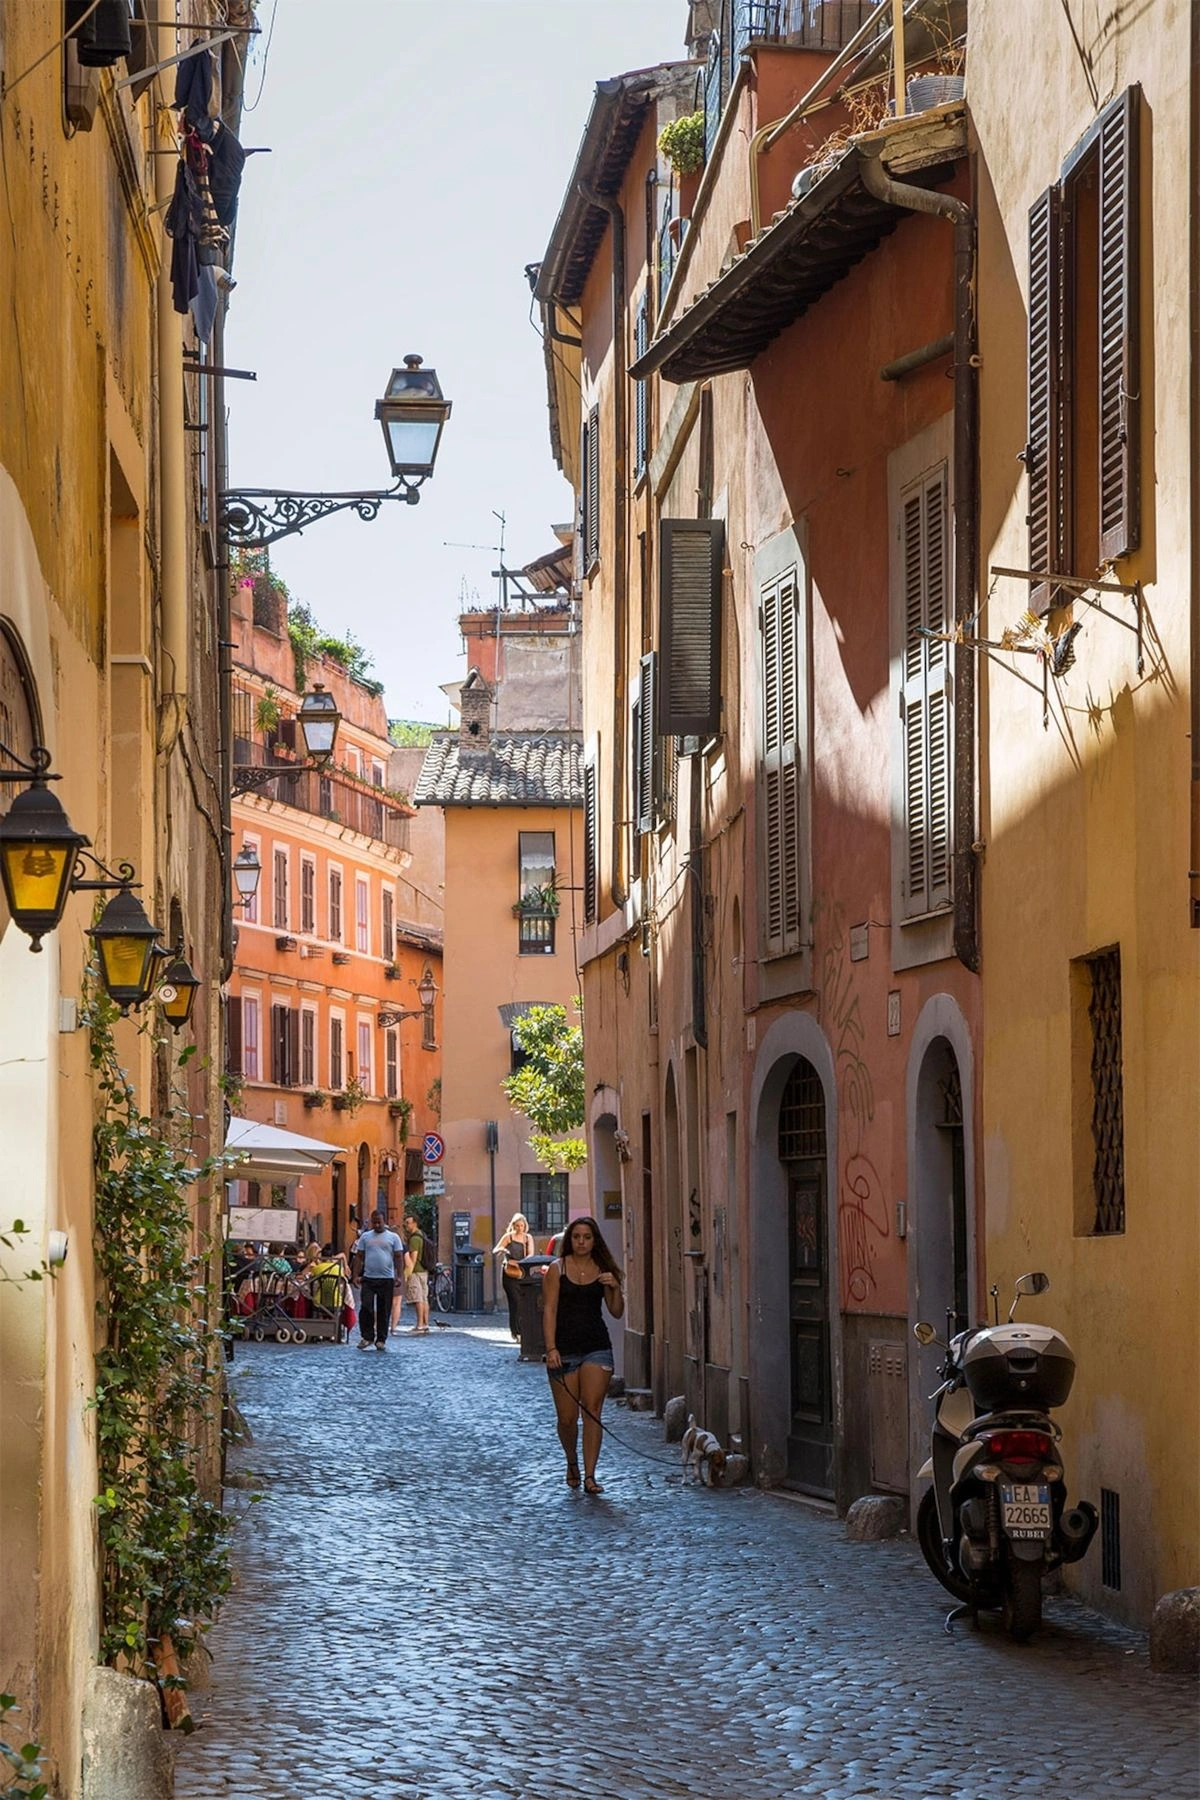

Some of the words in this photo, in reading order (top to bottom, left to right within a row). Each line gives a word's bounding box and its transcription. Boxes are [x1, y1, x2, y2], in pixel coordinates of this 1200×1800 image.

[1014, 1486, 1031, 1502] EA
[1006, 1507, 1048, 1524] 22665
[1012, 1530, 1044, 1538] RUBEI
